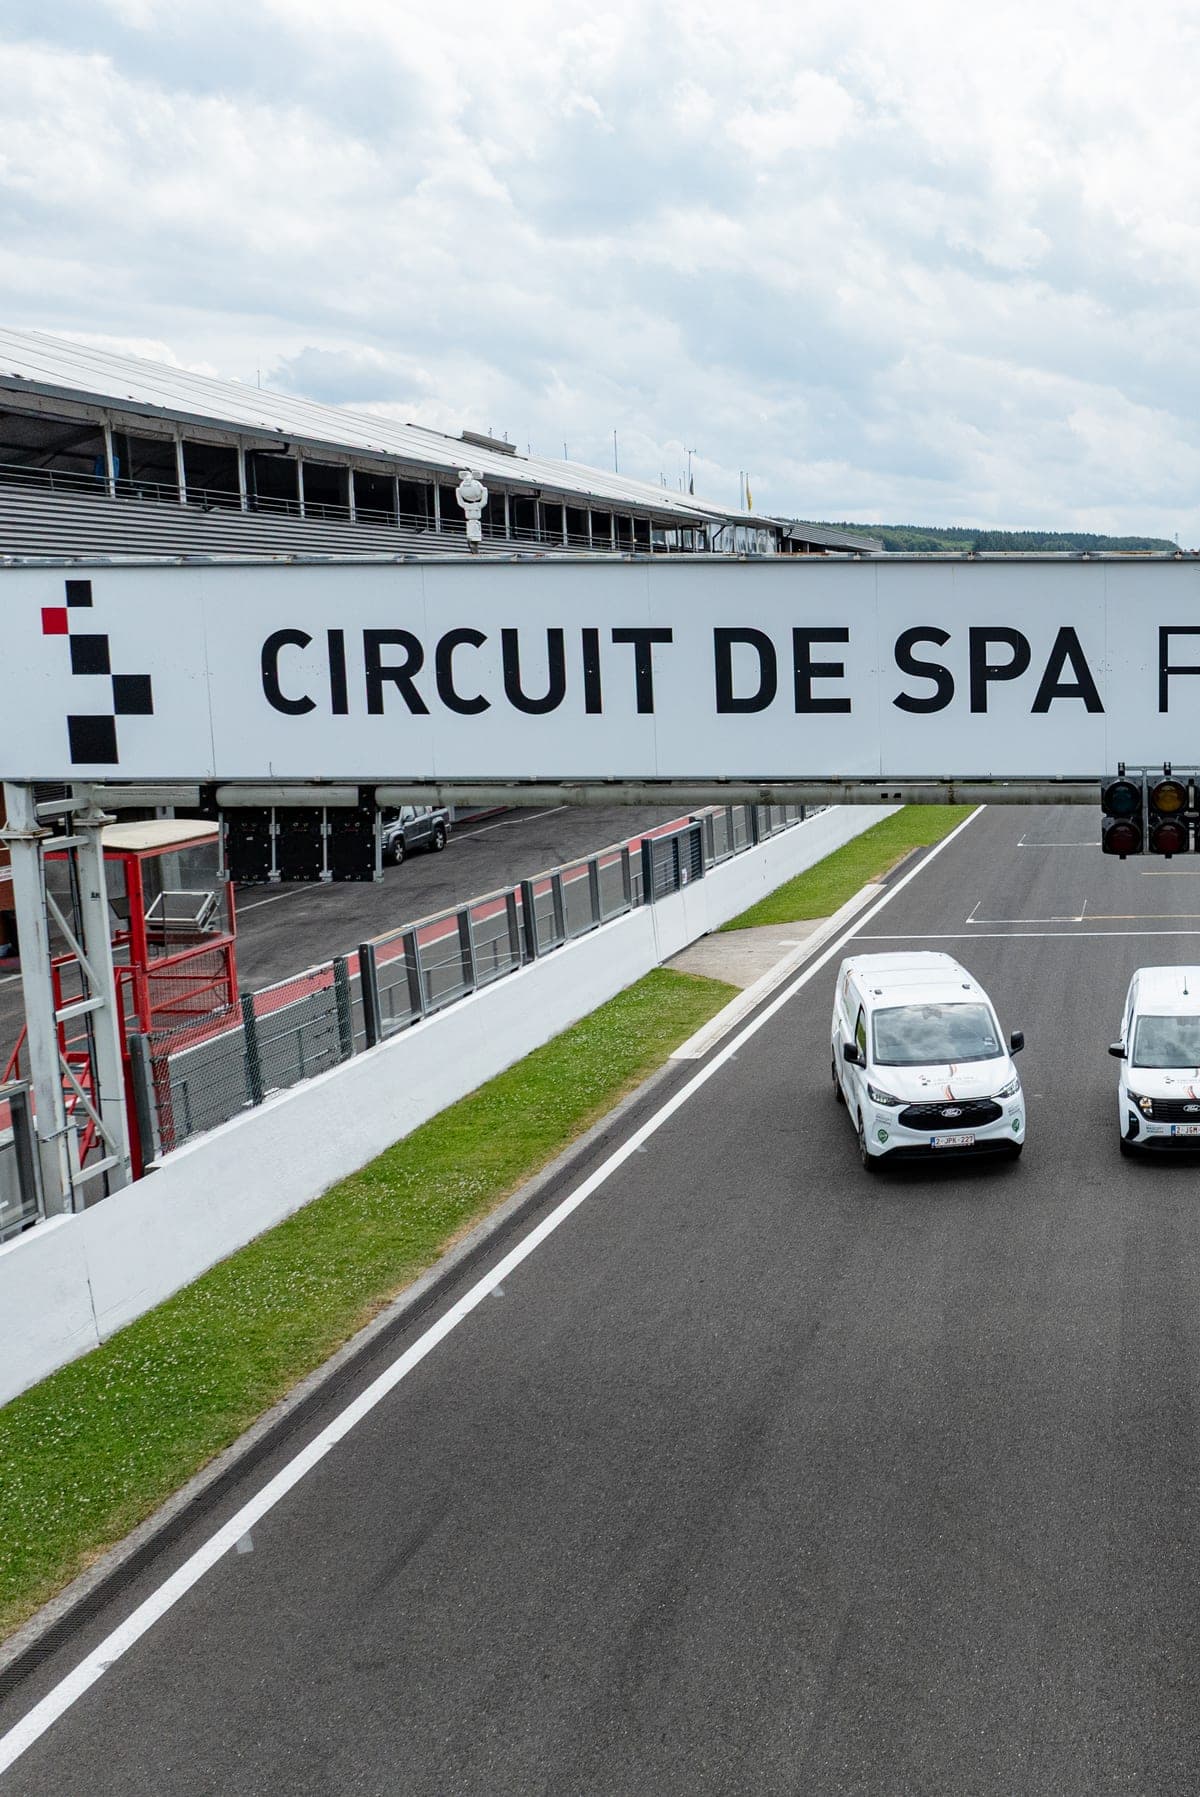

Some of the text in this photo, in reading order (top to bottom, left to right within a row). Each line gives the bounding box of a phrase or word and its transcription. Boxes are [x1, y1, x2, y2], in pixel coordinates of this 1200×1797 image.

[261, 627, 673, 715] CIRCUIT
[714, 627, 851, 714] DE
[893, 626, 1105, 714] SPA
